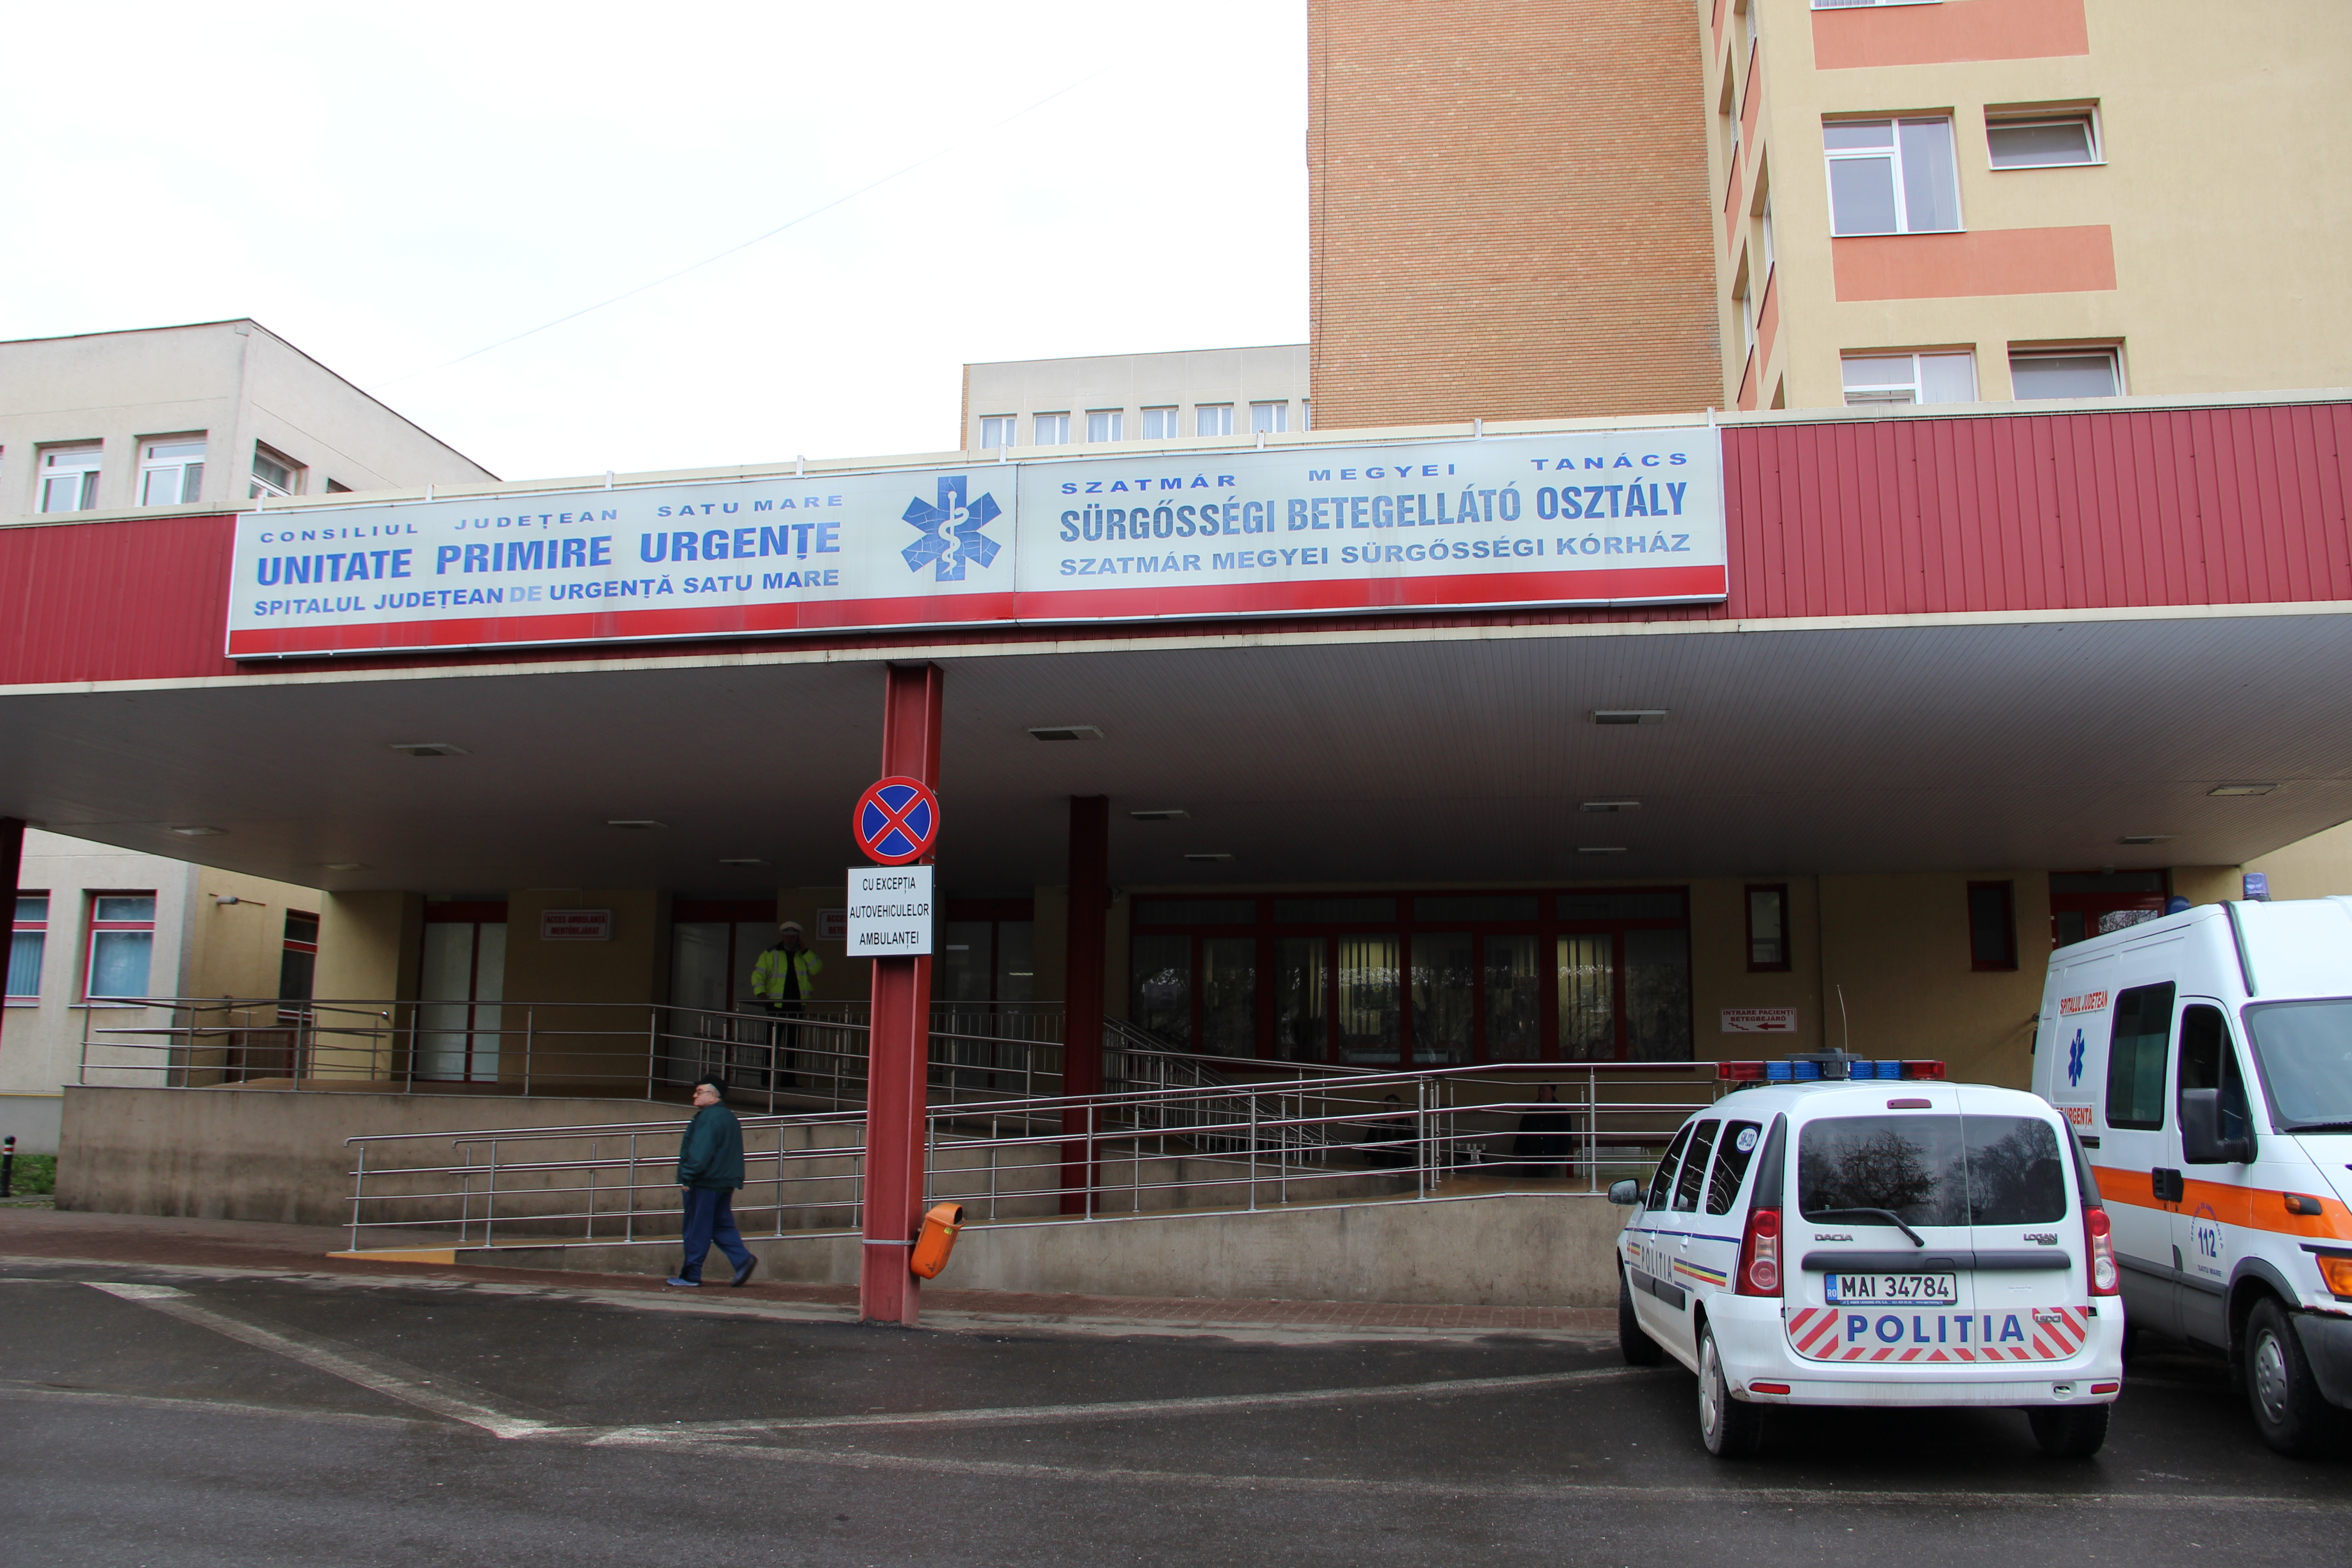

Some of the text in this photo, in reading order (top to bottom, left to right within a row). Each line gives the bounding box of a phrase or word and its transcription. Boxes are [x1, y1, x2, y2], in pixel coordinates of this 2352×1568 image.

[1060, 452, 1688, 494] SZATMÁR MEGYEI TANÁCS
[259, 495, 843, 543] CONSILIUL JUDEȚEAN SATU MARE
[1059, 475, 1688, 542] SÜRGŐSSÉGI BETEGELLÁTÓ OSZTÁLY
[256, 521, 841, 586] UNITATE PRIMIRE URGENȚE
[1059, 530, 1691, 576] SZATMÁR MEGYEI SÜRGŐSSÉGI KÓRHÁZ
[253, 569, 839, 616] SPITALUL JUDEȚEAN DE URGENȚĂ SATU MARE
[862, 877, 916, 894] CU EXCEPȚIA
[546, 915, 567, 924] ACCES
[849, 903, 930, 919] AUTOVEHICULELOR
[859, 931, 919, 949] AMBULANȚEI
[2060, 995, 2081, 1014] SPITALUL
[2198, 1226, 2217, 1258] 112
[2198, 1264, 2222, 1277] SATU MARE
[1827, 1289, 1837, 1298] RO
[1841, 1276, 1949, 1297] MAI 34784
[1847, 1314, 2025, 1343] POLITIA
